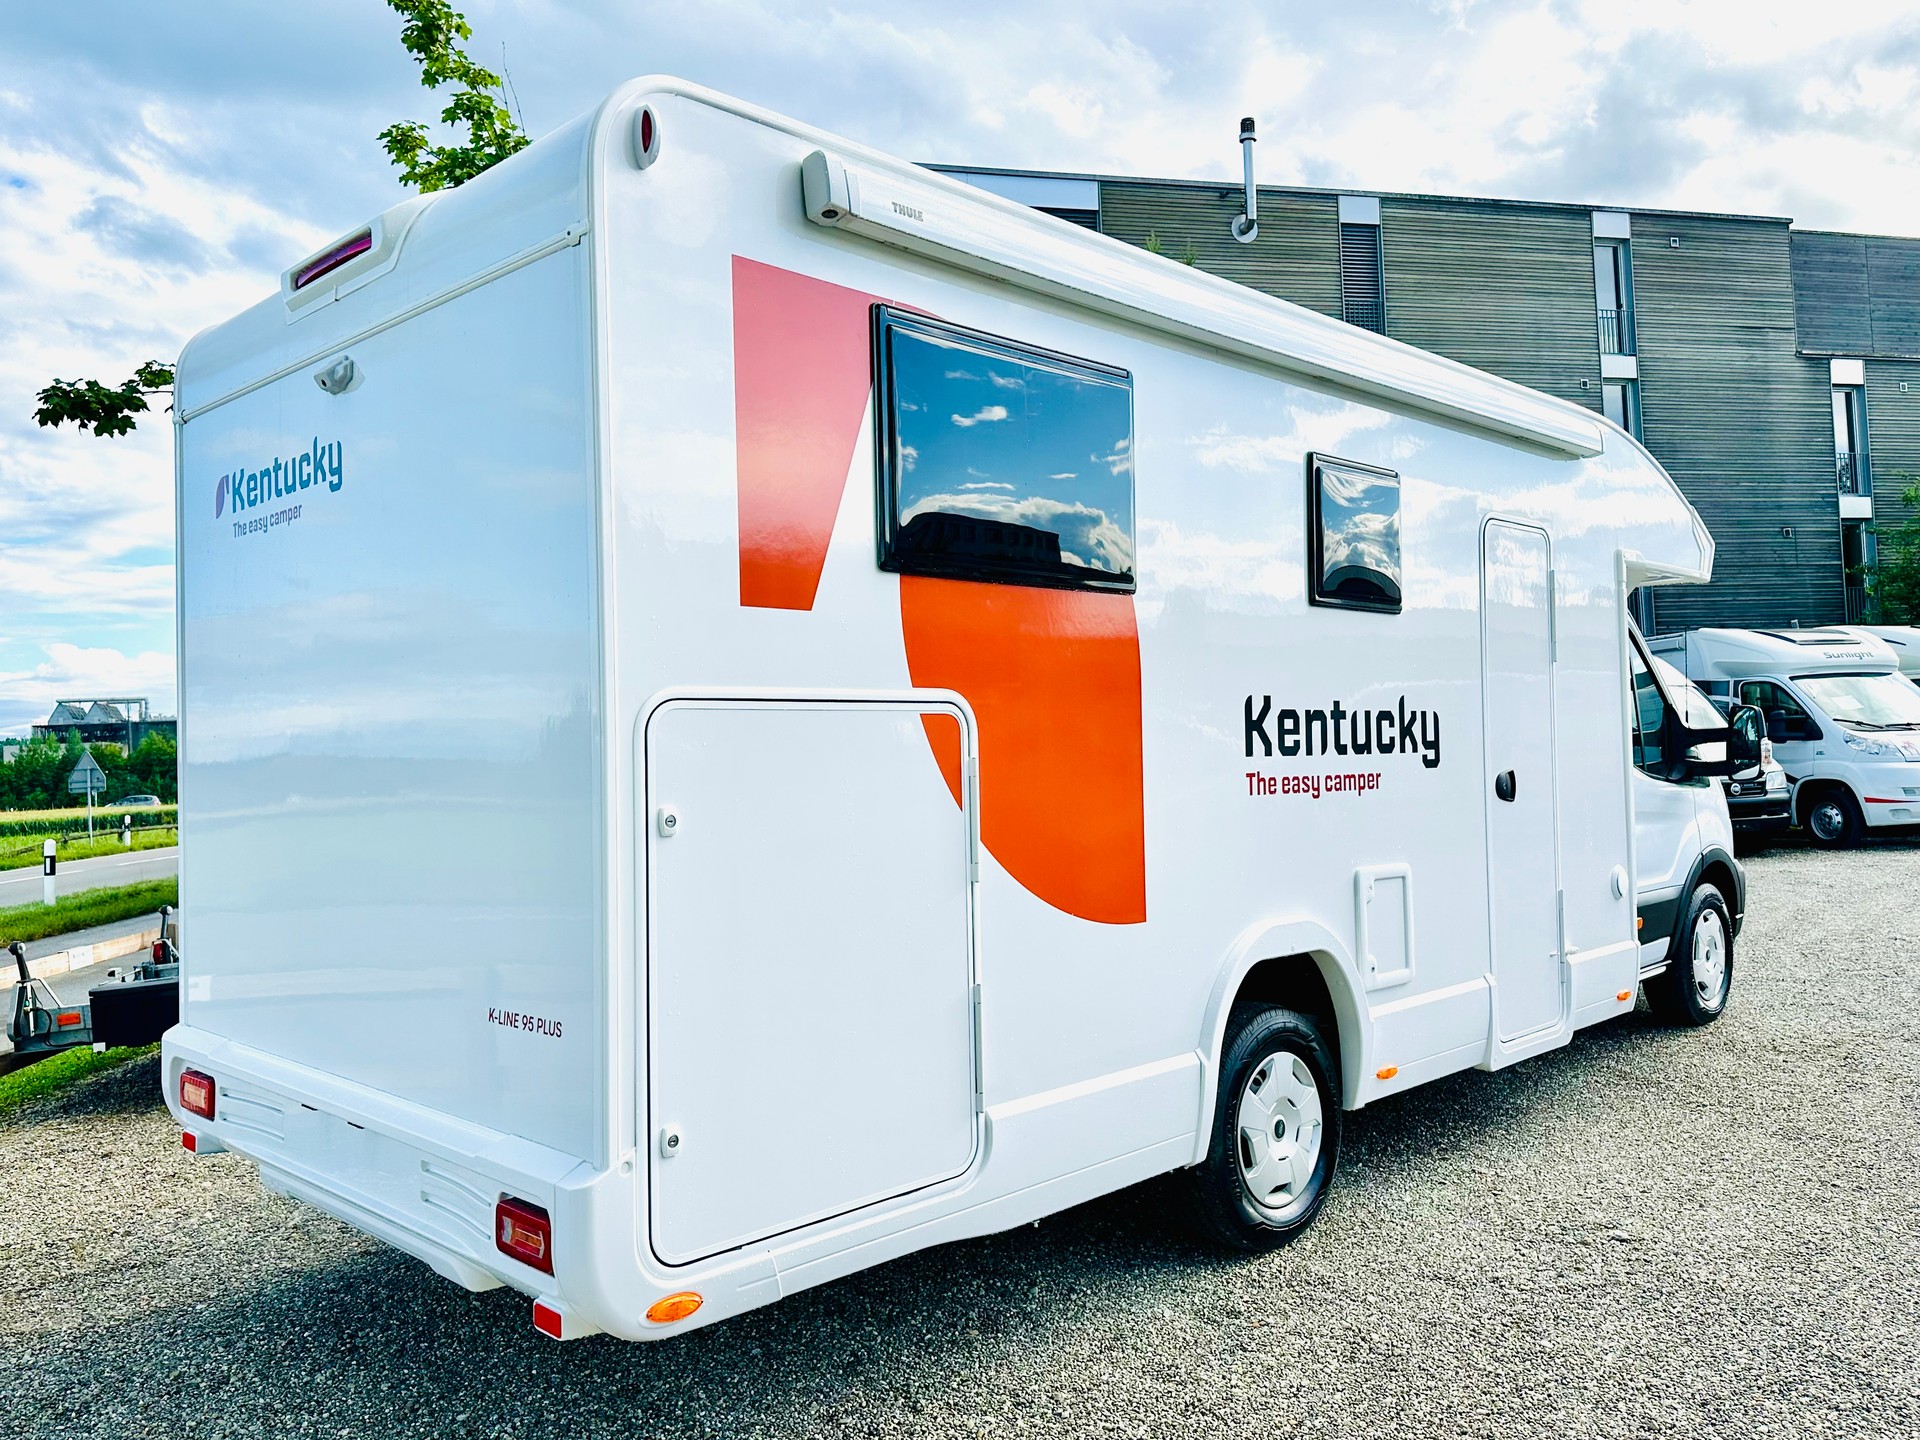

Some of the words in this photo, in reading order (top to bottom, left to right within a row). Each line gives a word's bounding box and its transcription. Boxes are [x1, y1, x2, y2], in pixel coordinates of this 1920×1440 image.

[892, 201, 924, 222] THULE
[232, 436, 343, 514] Kentucky
[233, 521, 247, 538] The
[248, 515, 268, 533] easy
[269, 504, 303, 526] camper
[1823, 651, 1875, 660] Sunlight
[1244, 695, 1441, 769] Kentucky
[1245, 771, 1277, 796] The
[1281, 773, 1321, 799] easy
[1324, 772, 1382, 797] camper
[488, 1007, 520, 1029] K-LINE
[521, 1014, 535, 1032] 95
[536, 1017, 563, 1038] PLUS
